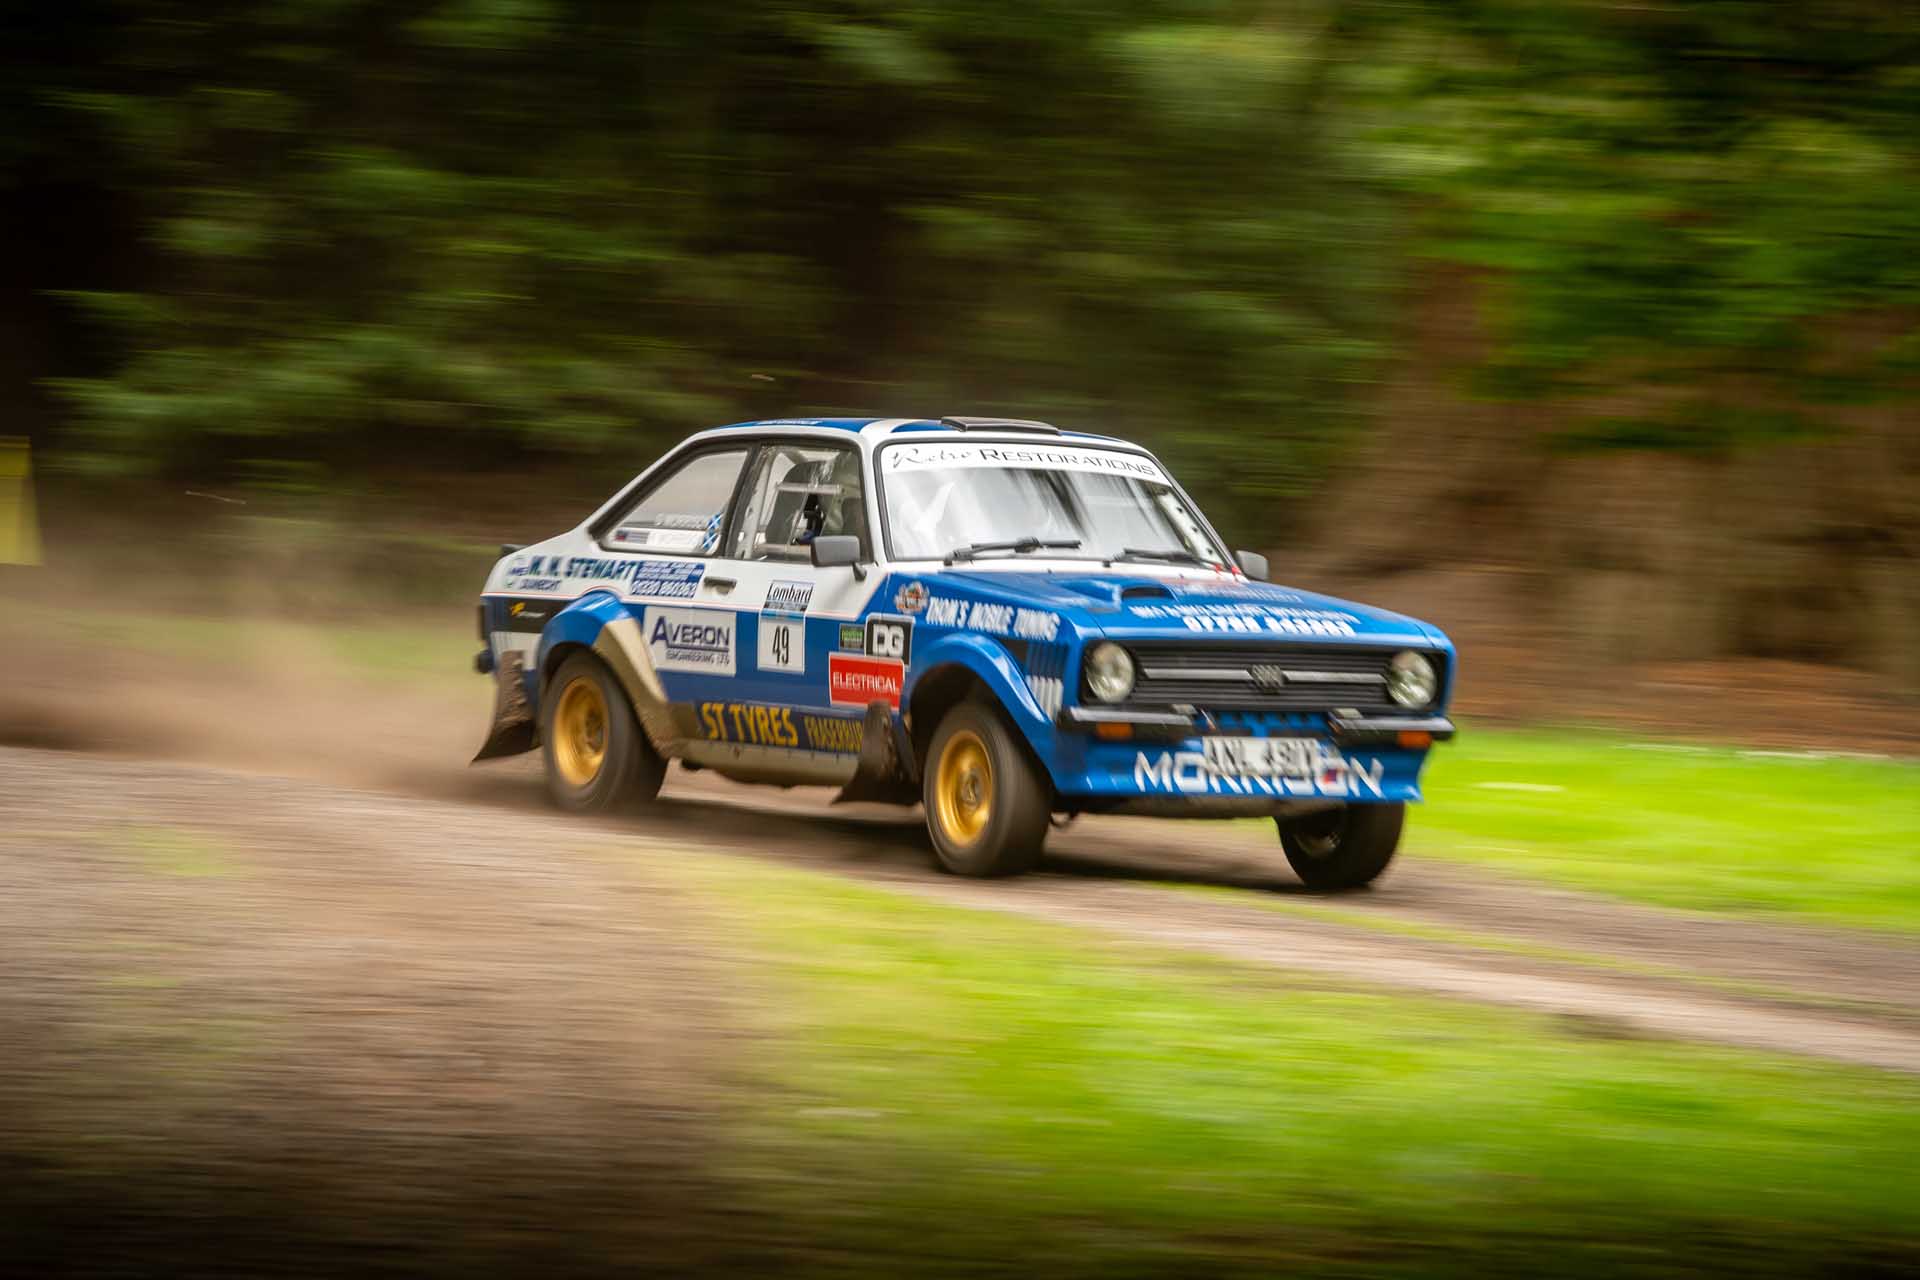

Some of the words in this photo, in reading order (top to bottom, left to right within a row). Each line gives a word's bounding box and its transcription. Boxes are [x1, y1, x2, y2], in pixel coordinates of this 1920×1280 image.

[979, 448, 1156, 476] RESTORATIONS
[565, 557, 638, 581] STEWART
[766, 583, 814, 603] Lombard
[651, 615, 730, 646] AVERON
[772, 625, 790, 665] 49
[872, 624, 904, 657] DG
[833, 671, 899, 692] ELECTRICAL
[702, 703, 728, 741] ST
[729, 705, 799, 747] TYRES
